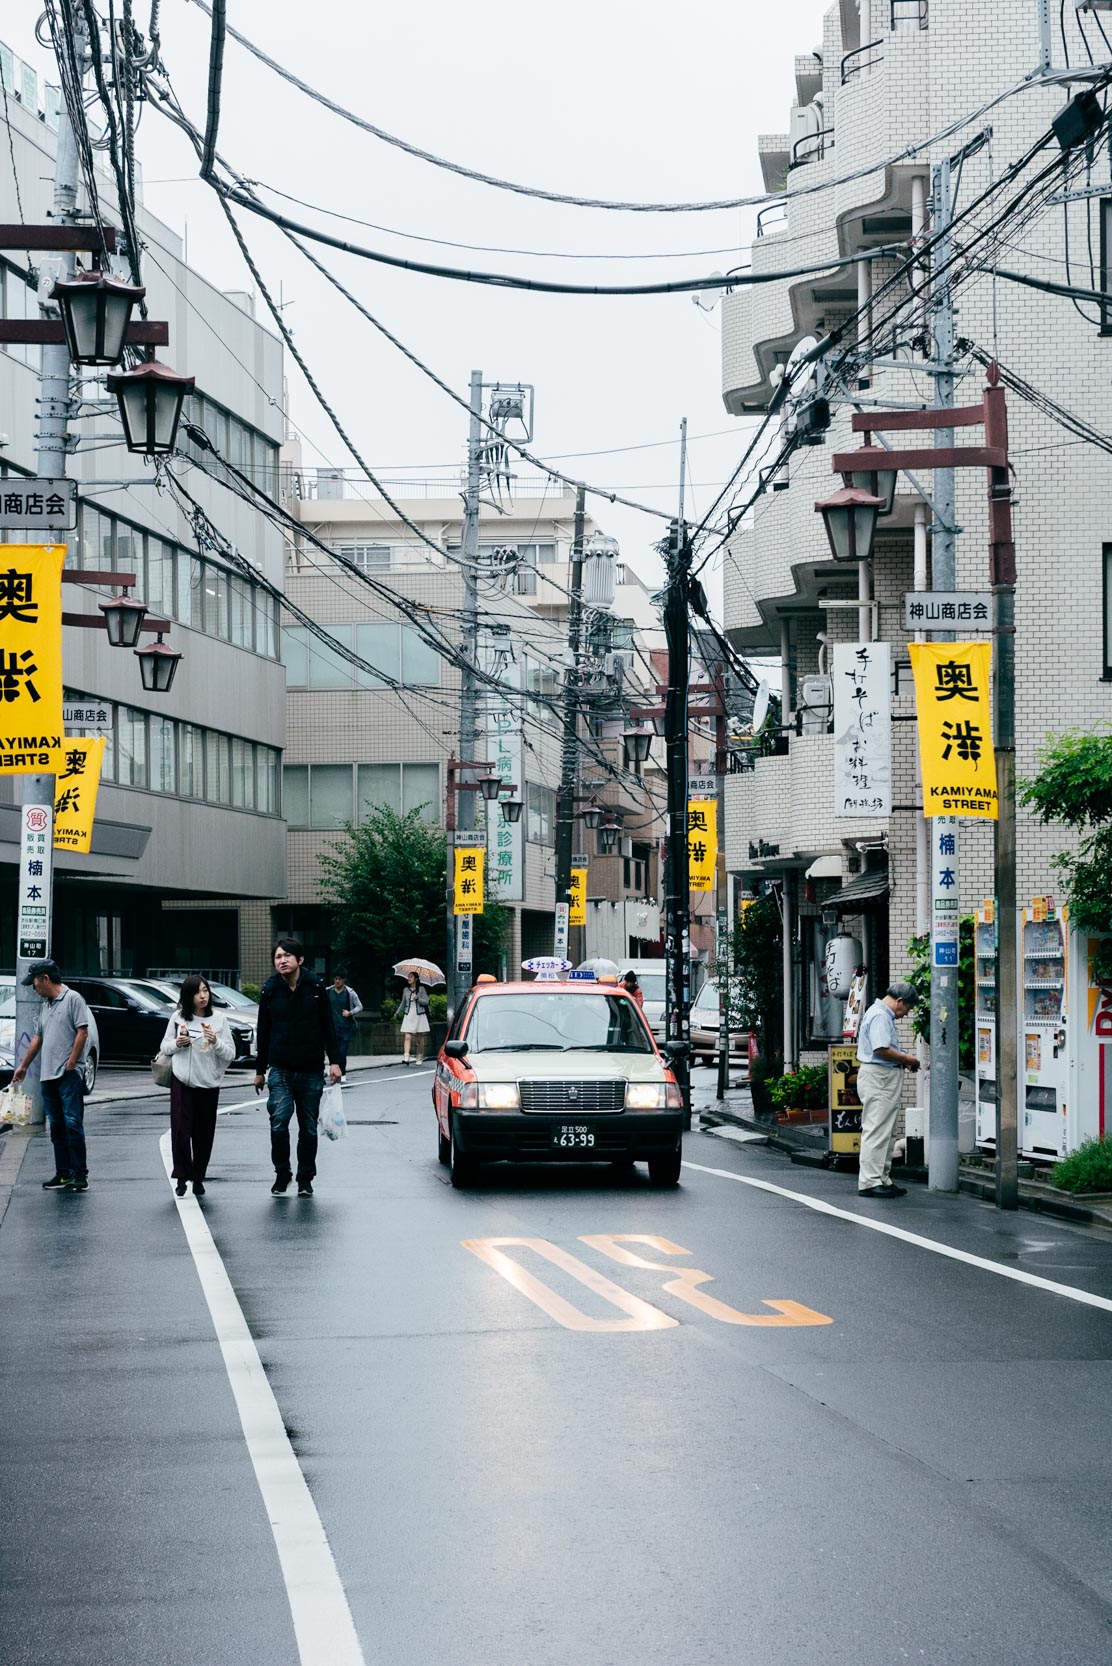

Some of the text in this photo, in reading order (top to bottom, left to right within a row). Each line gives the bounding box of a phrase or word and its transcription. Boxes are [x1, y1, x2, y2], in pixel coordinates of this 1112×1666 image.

[0, 492, 65, 516] 商店会
[909, 602, 988, 621] 神山商店会
[934, 660, 983, 771] 奥渋
[688, 780, 714, 789] 商店会
[930, 786, 998, 799] KAMIYAMA
[943, 799, 991, 811] STREET
[31, 812, 43, 827] 質
[939, 832, 955, 890] 楠本
[27, 859, 43, 901] 楠本
[536, 961, 559, 969] チェッカー
[560, 1134, 594, 1146] 63-99
